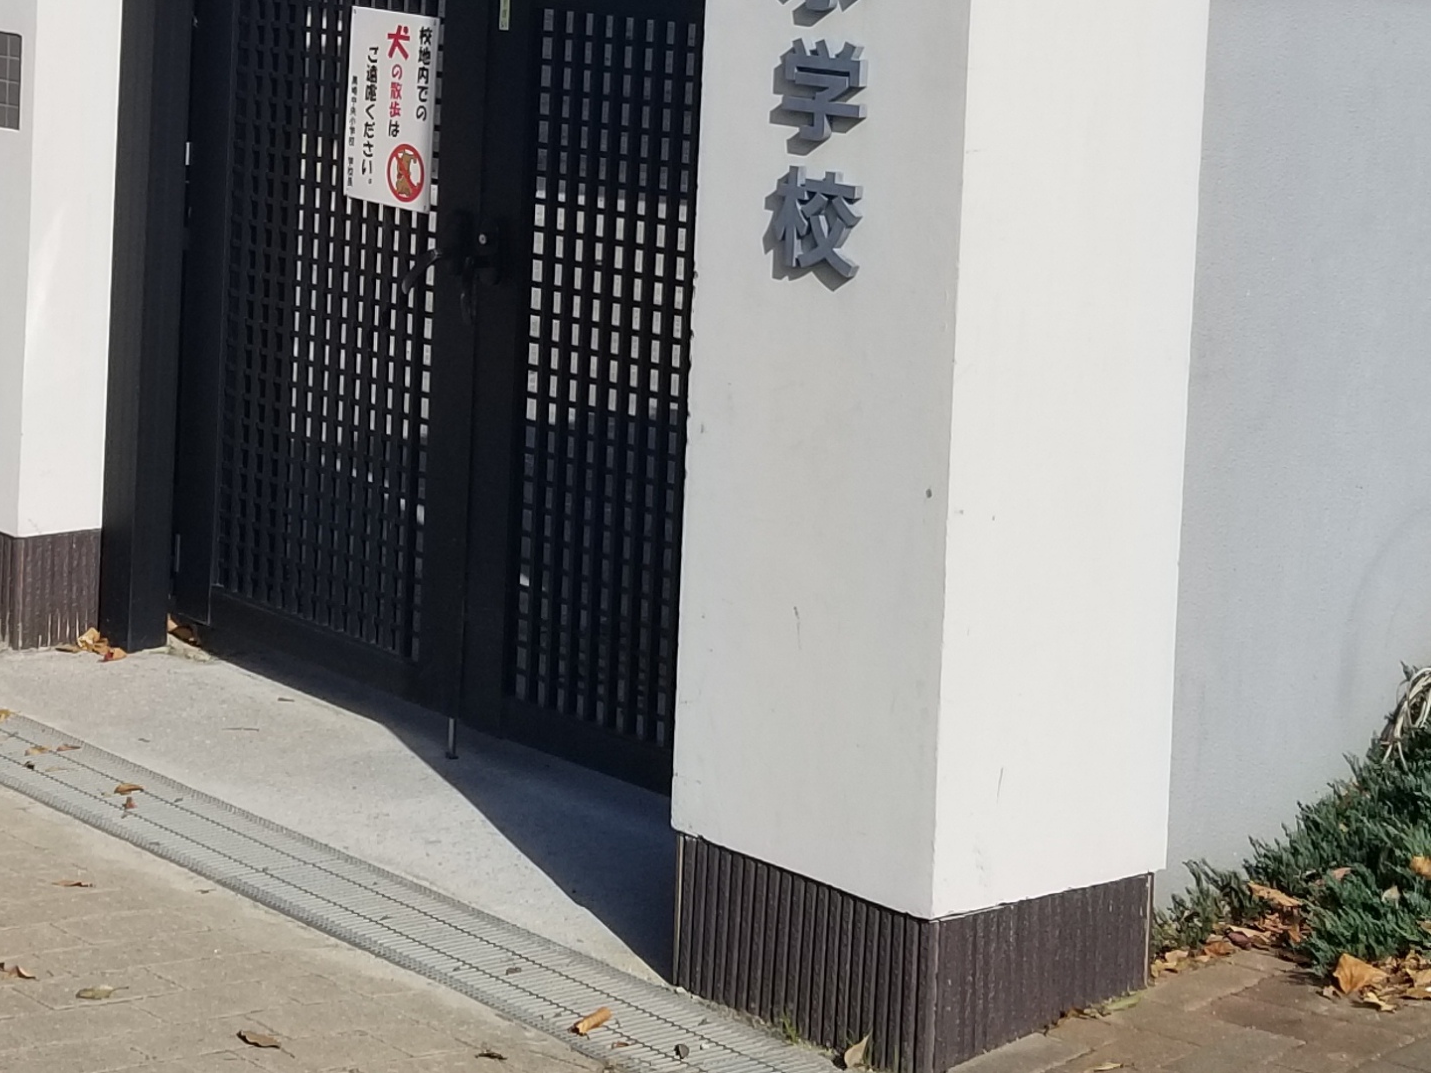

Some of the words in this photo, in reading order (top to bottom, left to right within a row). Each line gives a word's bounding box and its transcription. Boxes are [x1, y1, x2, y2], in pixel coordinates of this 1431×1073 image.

[361, 46, 380, 185] ご遠慮ください。
[387, 25, 411, 138] 犬の散歩は
[416, 26, 433, 122] 校地内での
